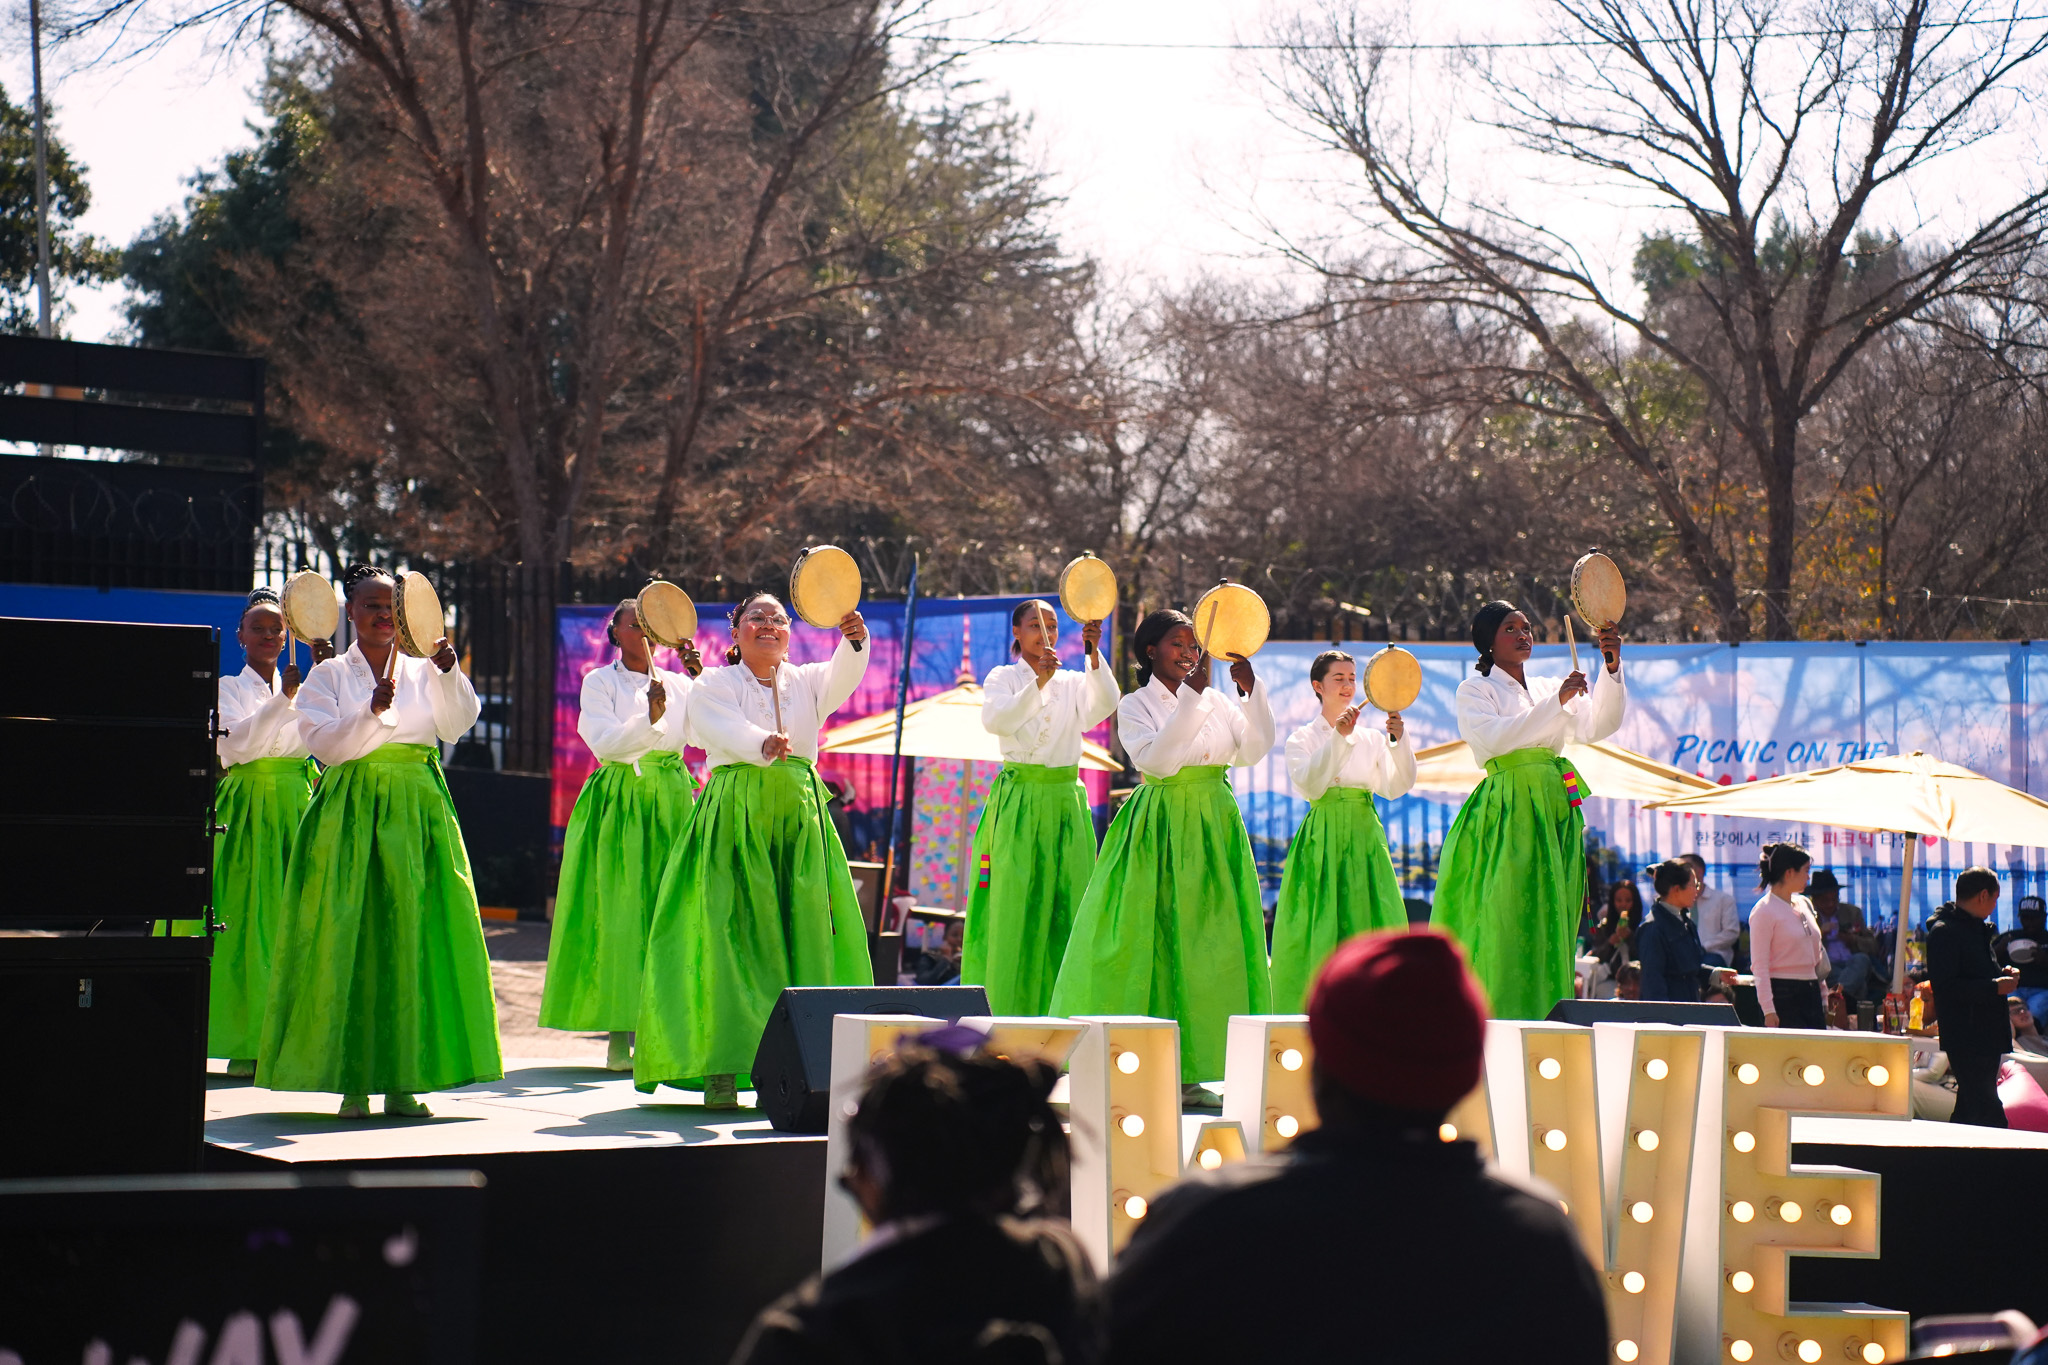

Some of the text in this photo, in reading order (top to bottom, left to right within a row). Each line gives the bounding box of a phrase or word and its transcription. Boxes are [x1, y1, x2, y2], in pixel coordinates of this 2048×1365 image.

[1672, 734, 1889, 766] PICNIC ON THE
[1695, 830, 1761, 848] 한강에서
